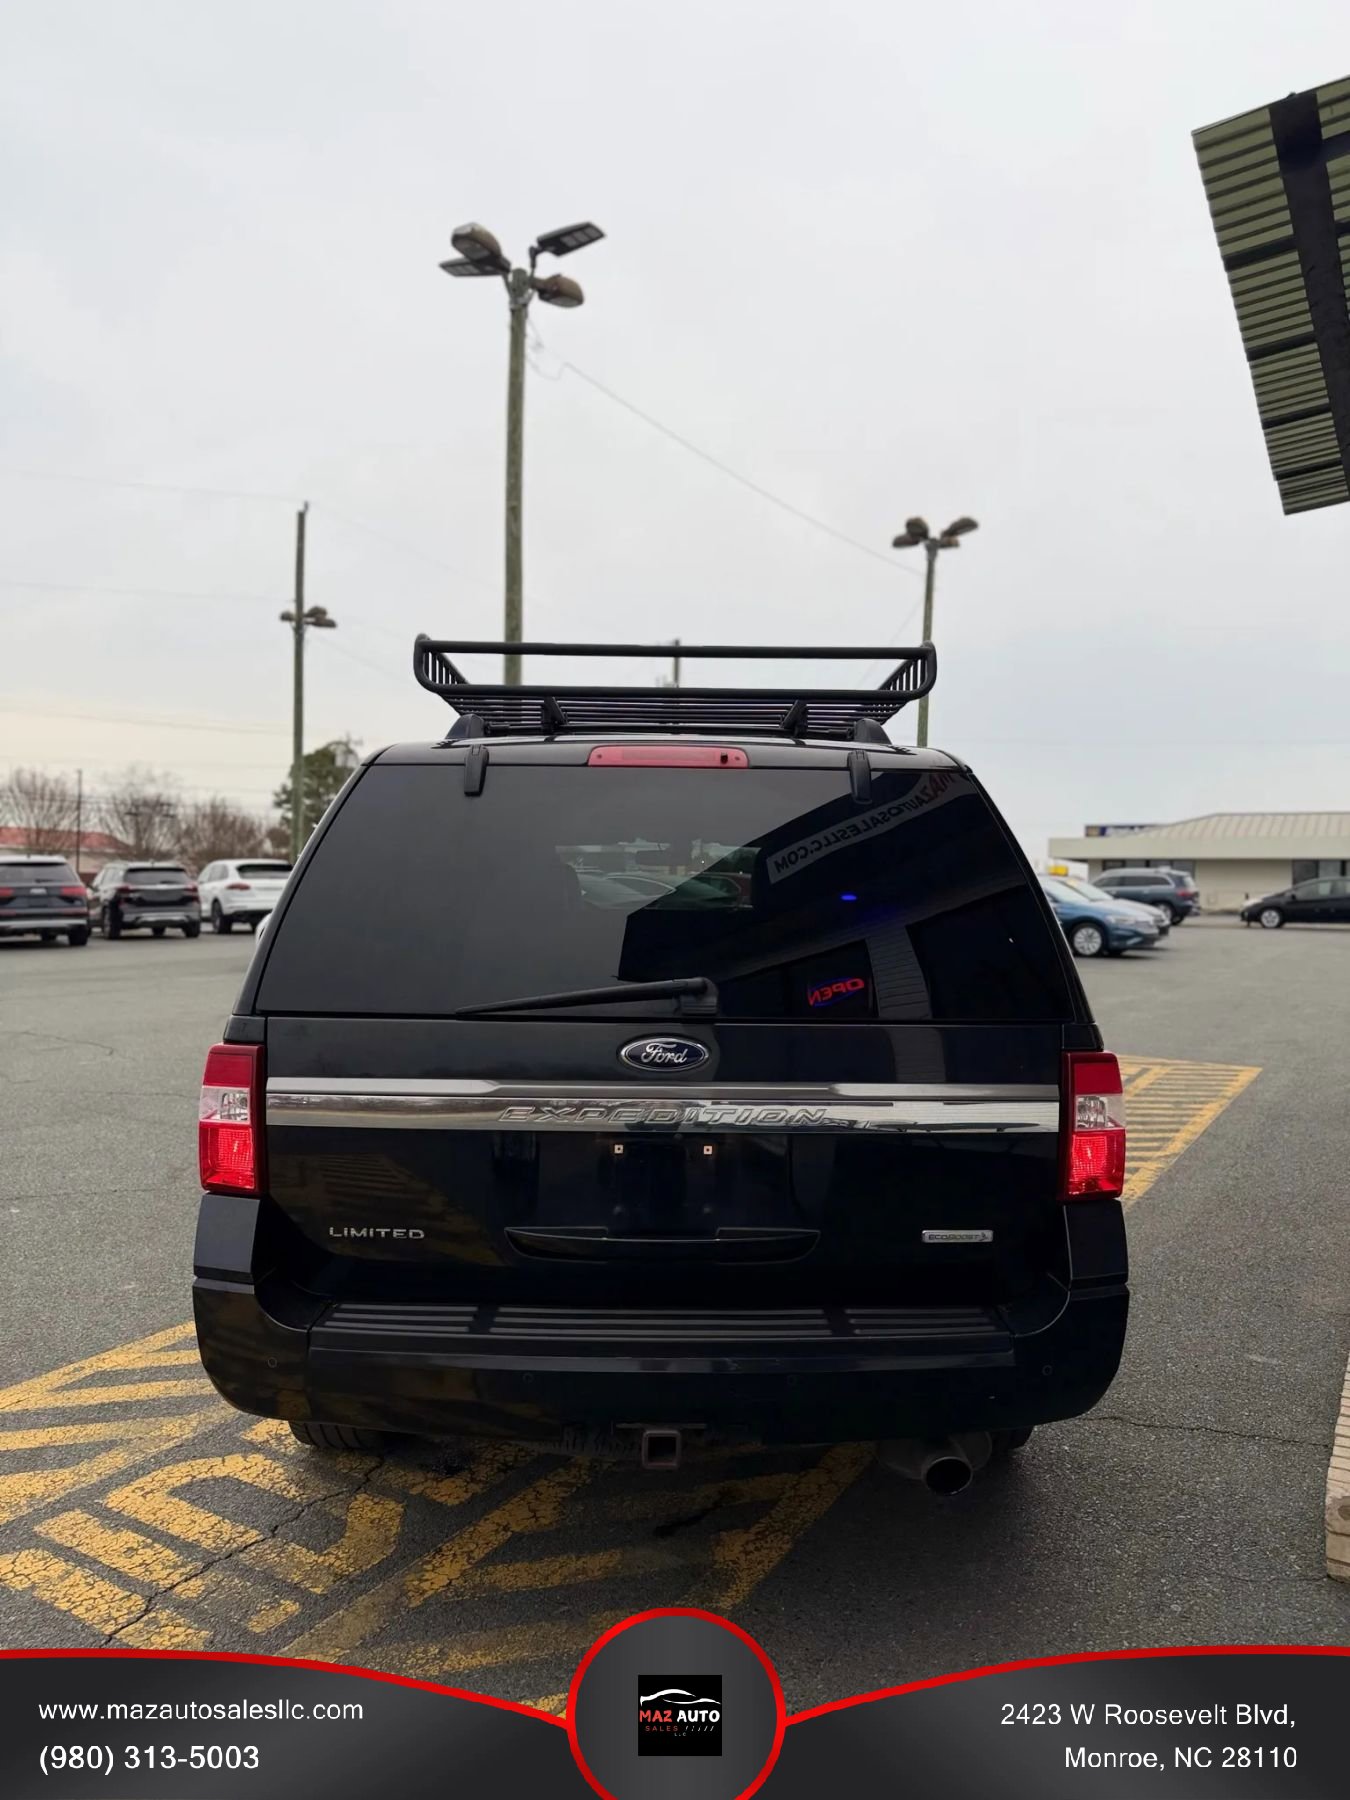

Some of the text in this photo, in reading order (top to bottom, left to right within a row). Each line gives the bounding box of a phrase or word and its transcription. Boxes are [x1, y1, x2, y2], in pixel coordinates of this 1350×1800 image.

[640, 1042, 688, 1064] Ford
[498, 1105, 829, 1126] EXPEDITION
[329, 1226, 425, 1239] LIMITED
